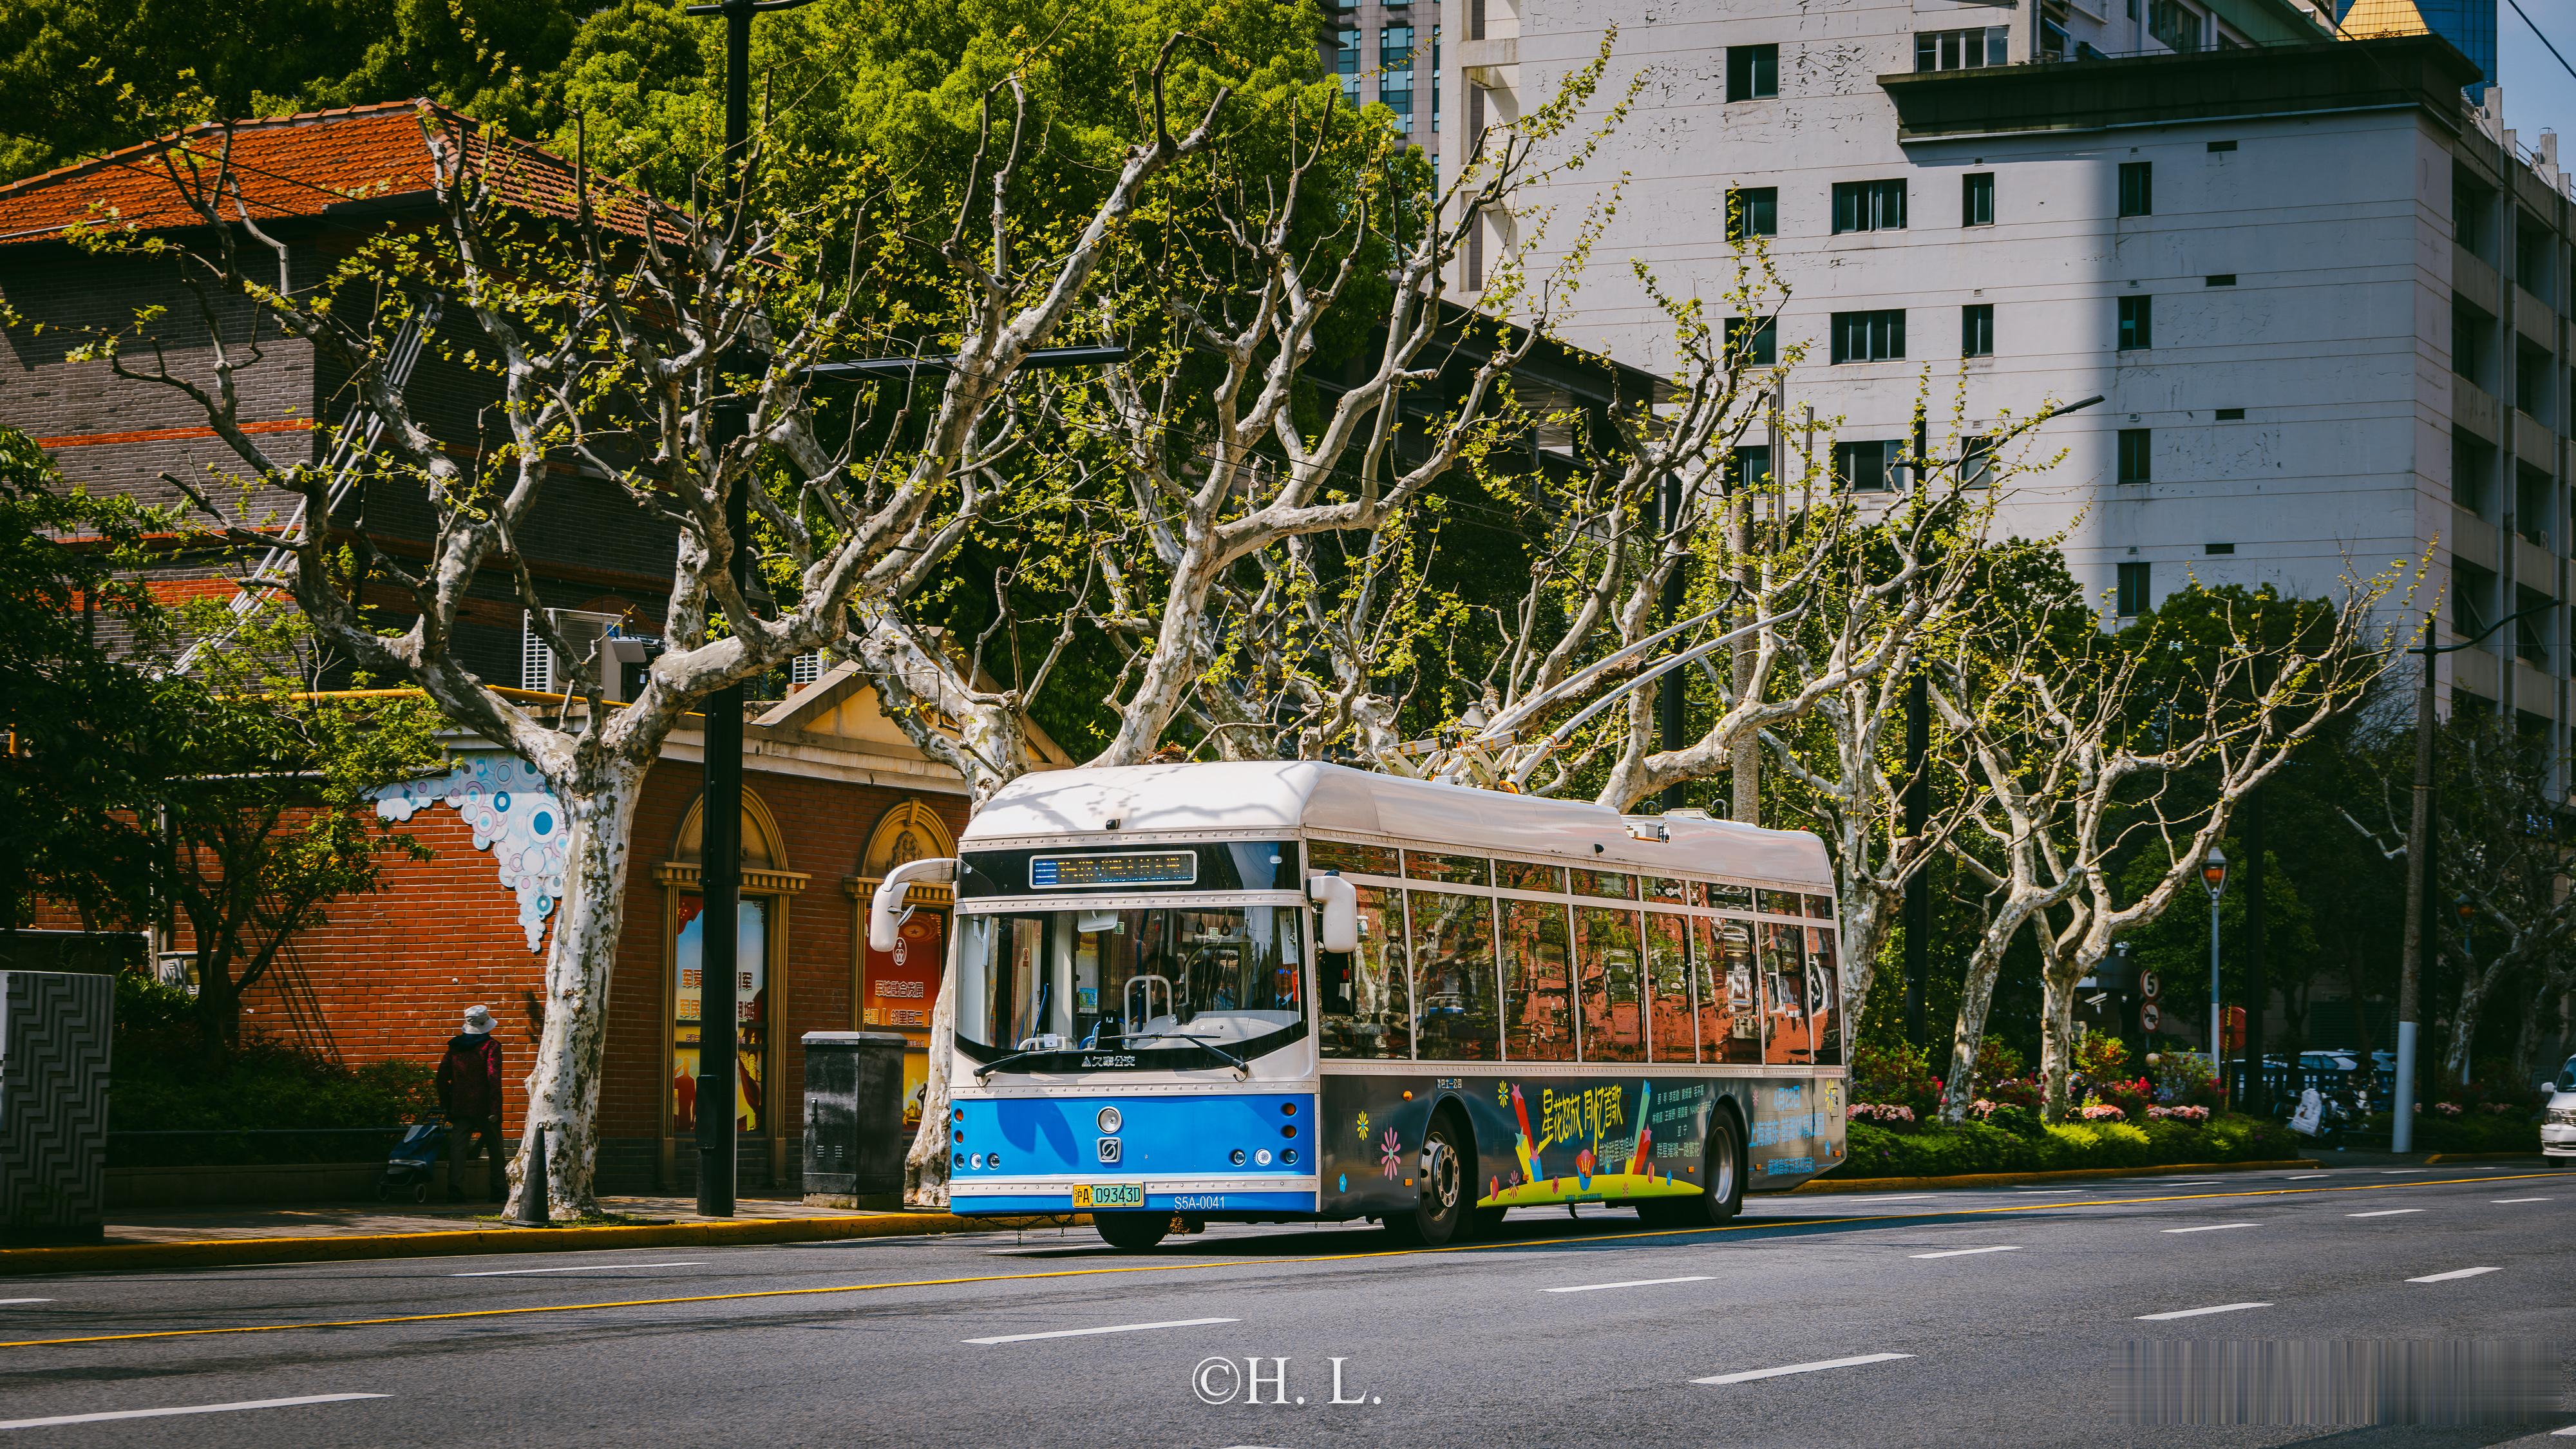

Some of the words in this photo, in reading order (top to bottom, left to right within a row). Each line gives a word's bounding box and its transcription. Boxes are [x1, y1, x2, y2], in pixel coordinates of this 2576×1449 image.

[875, 980, 923, 998] 军地融合发展
[2147, 975, 2154, 994] 5
[1092, 1056, 1135, 1066] 久事公交
[1537, 1088, 1584, 1155] 星花怒放
[1174, 1195, 1225, 1209] S5A-0041
